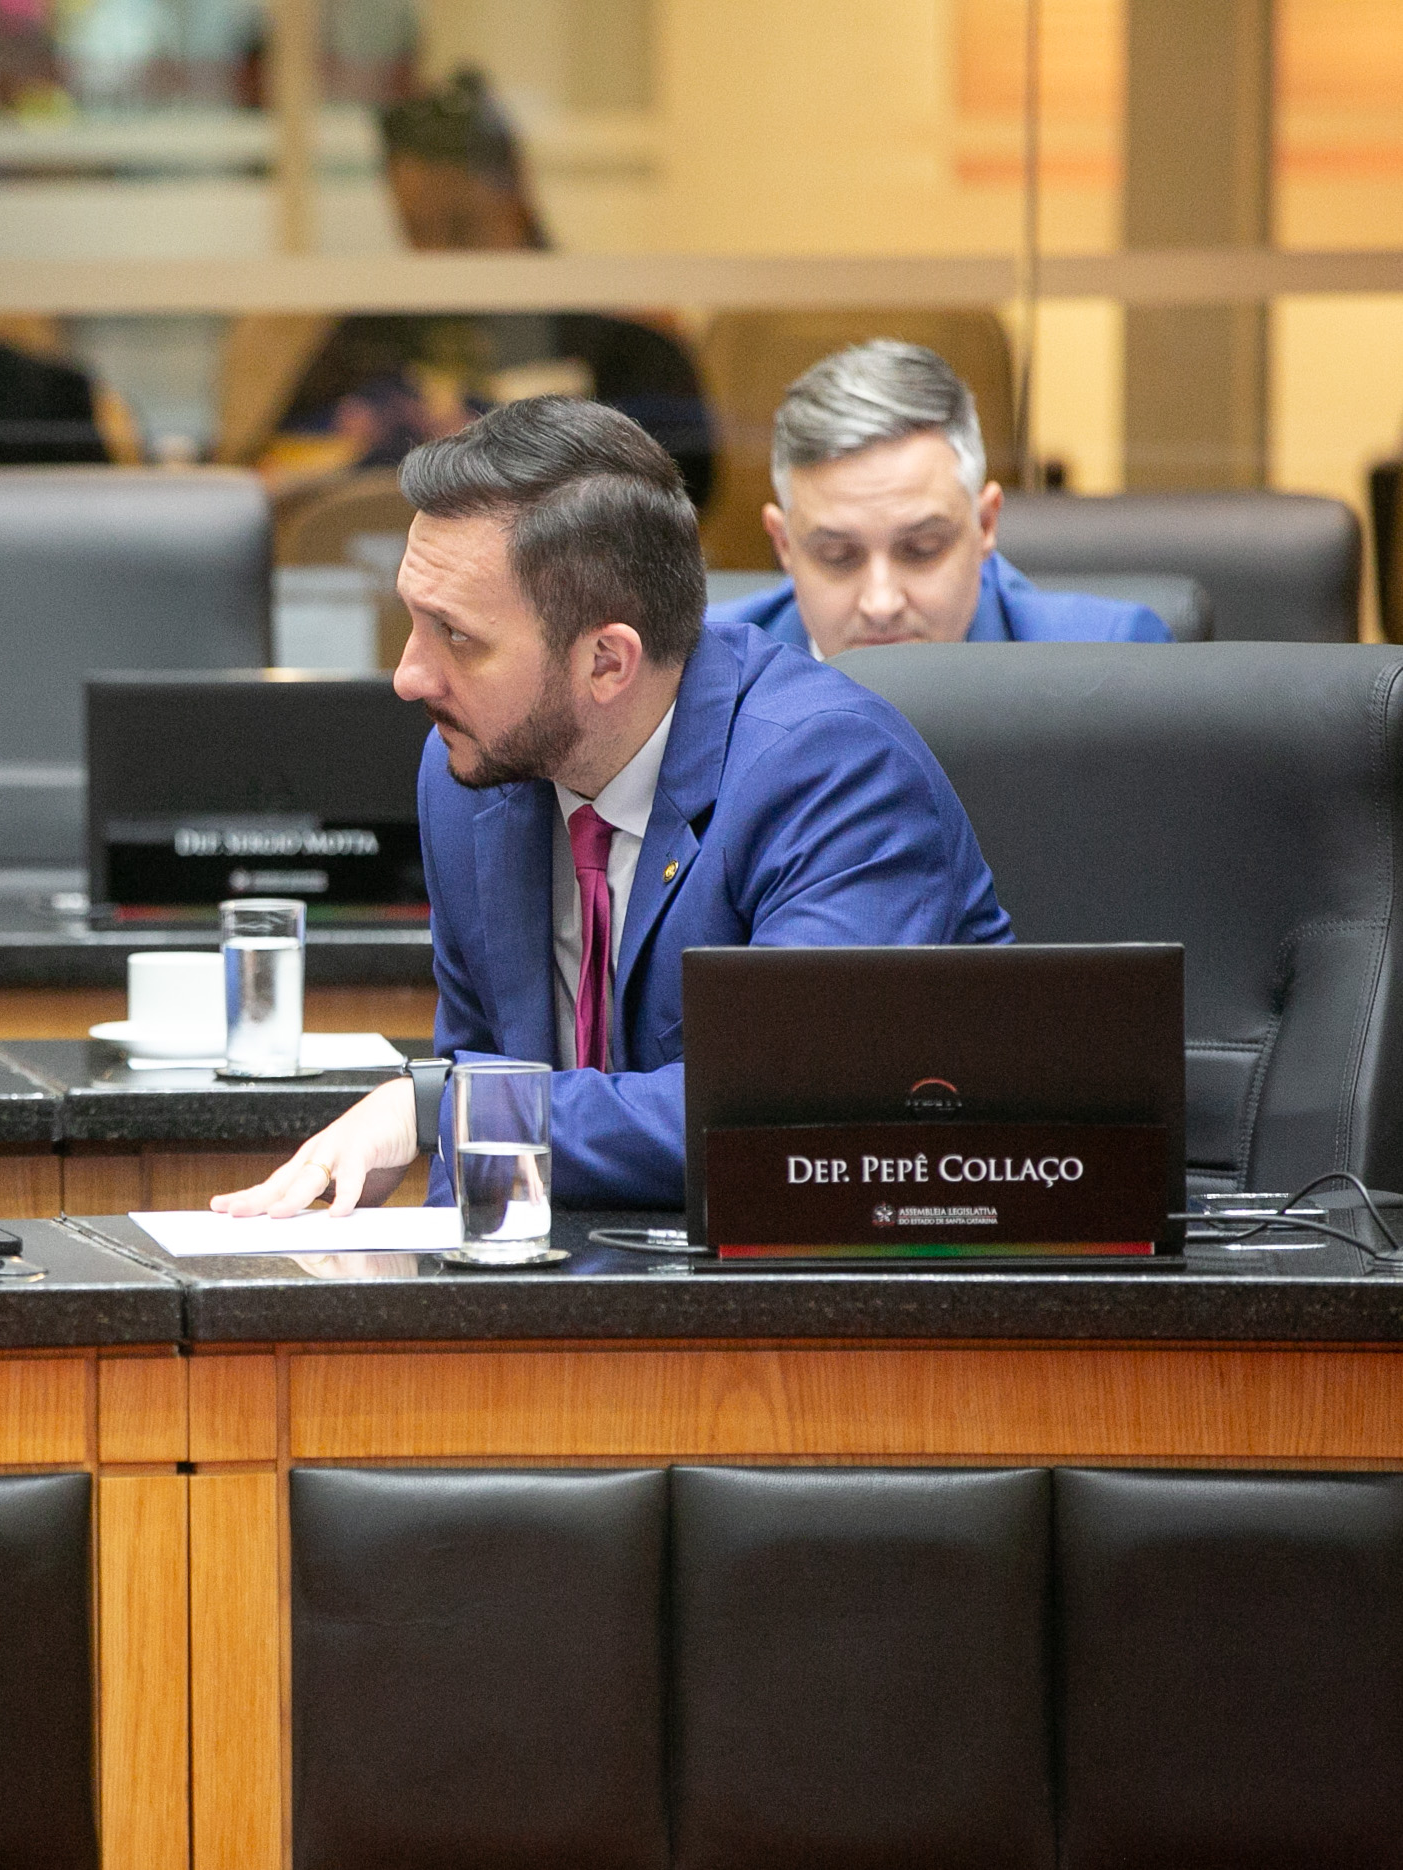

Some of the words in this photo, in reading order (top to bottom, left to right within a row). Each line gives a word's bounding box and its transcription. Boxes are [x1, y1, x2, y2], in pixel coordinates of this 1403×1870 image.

[787, 1155, 850, 1183] DEP.
[861, 1152, 929, 1183] PEPÊ
[938, 1153, 1084, 1188] COLLAÇO
[899, 1207, 947, 1216] ASSEMBLEIA
[948, 1207, 997, 1216] LEGISLATIVA
